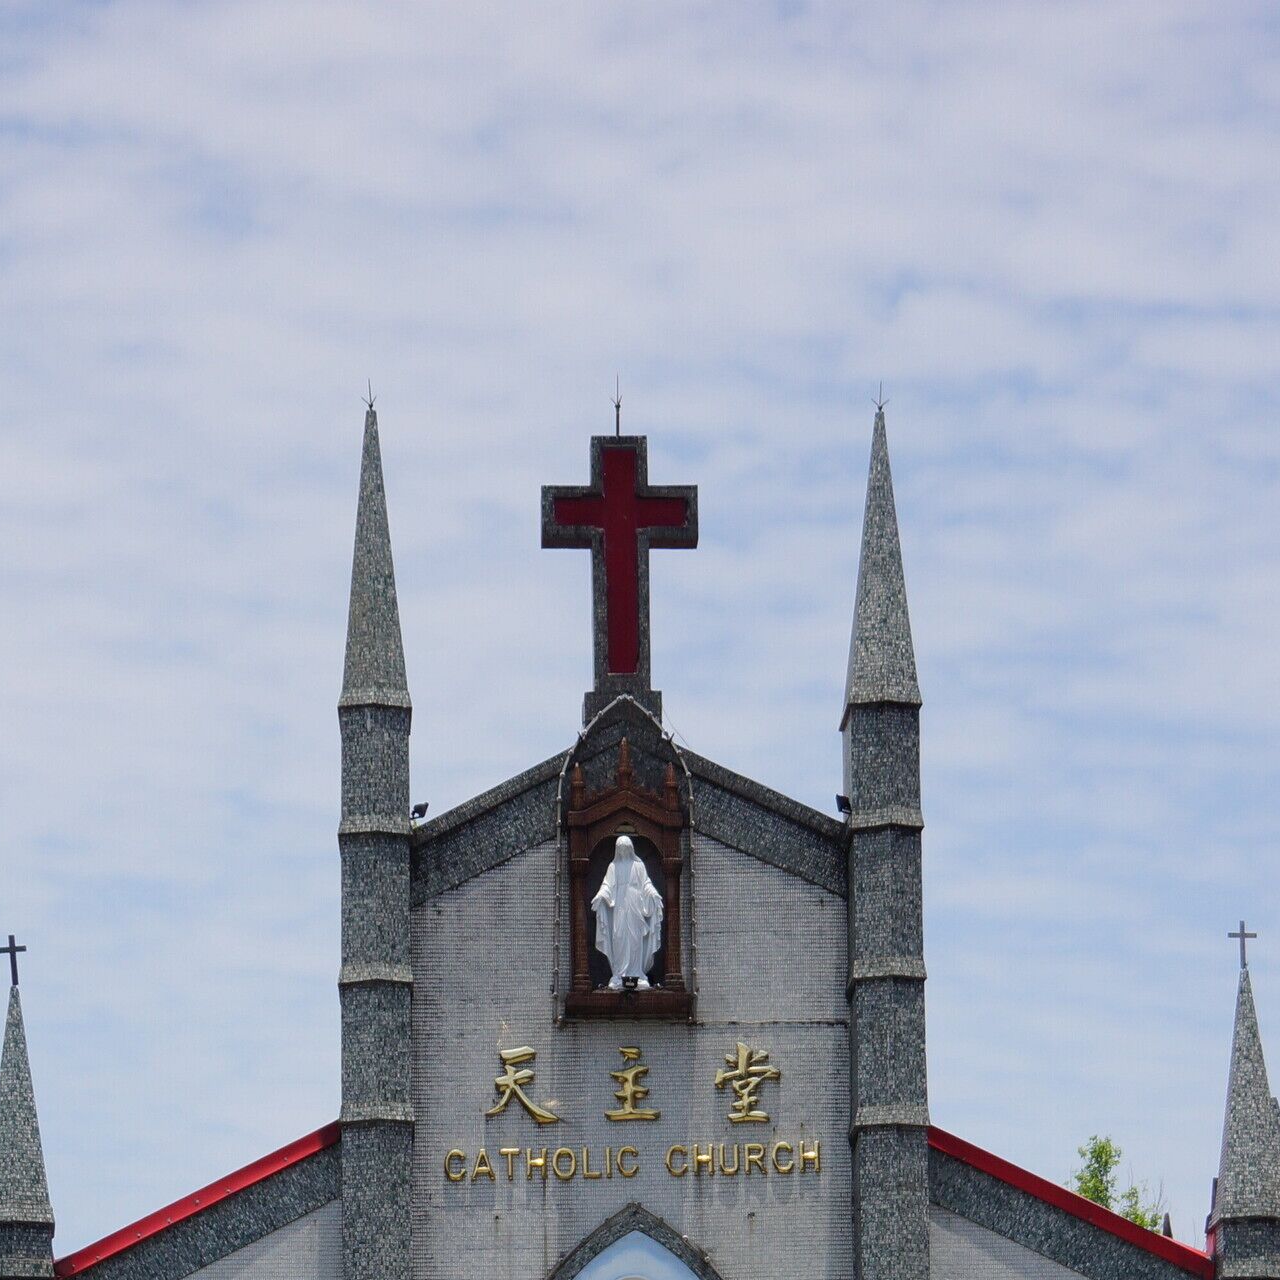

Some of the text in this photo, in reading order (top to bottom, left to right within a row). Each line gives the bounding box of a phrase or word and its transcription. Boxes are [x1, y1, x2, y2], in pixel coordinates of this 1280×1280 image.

[484, 1041, 782, 1124] 天主堂
[443, 1139, 822, 1182] CATHOLIC CHURCH
